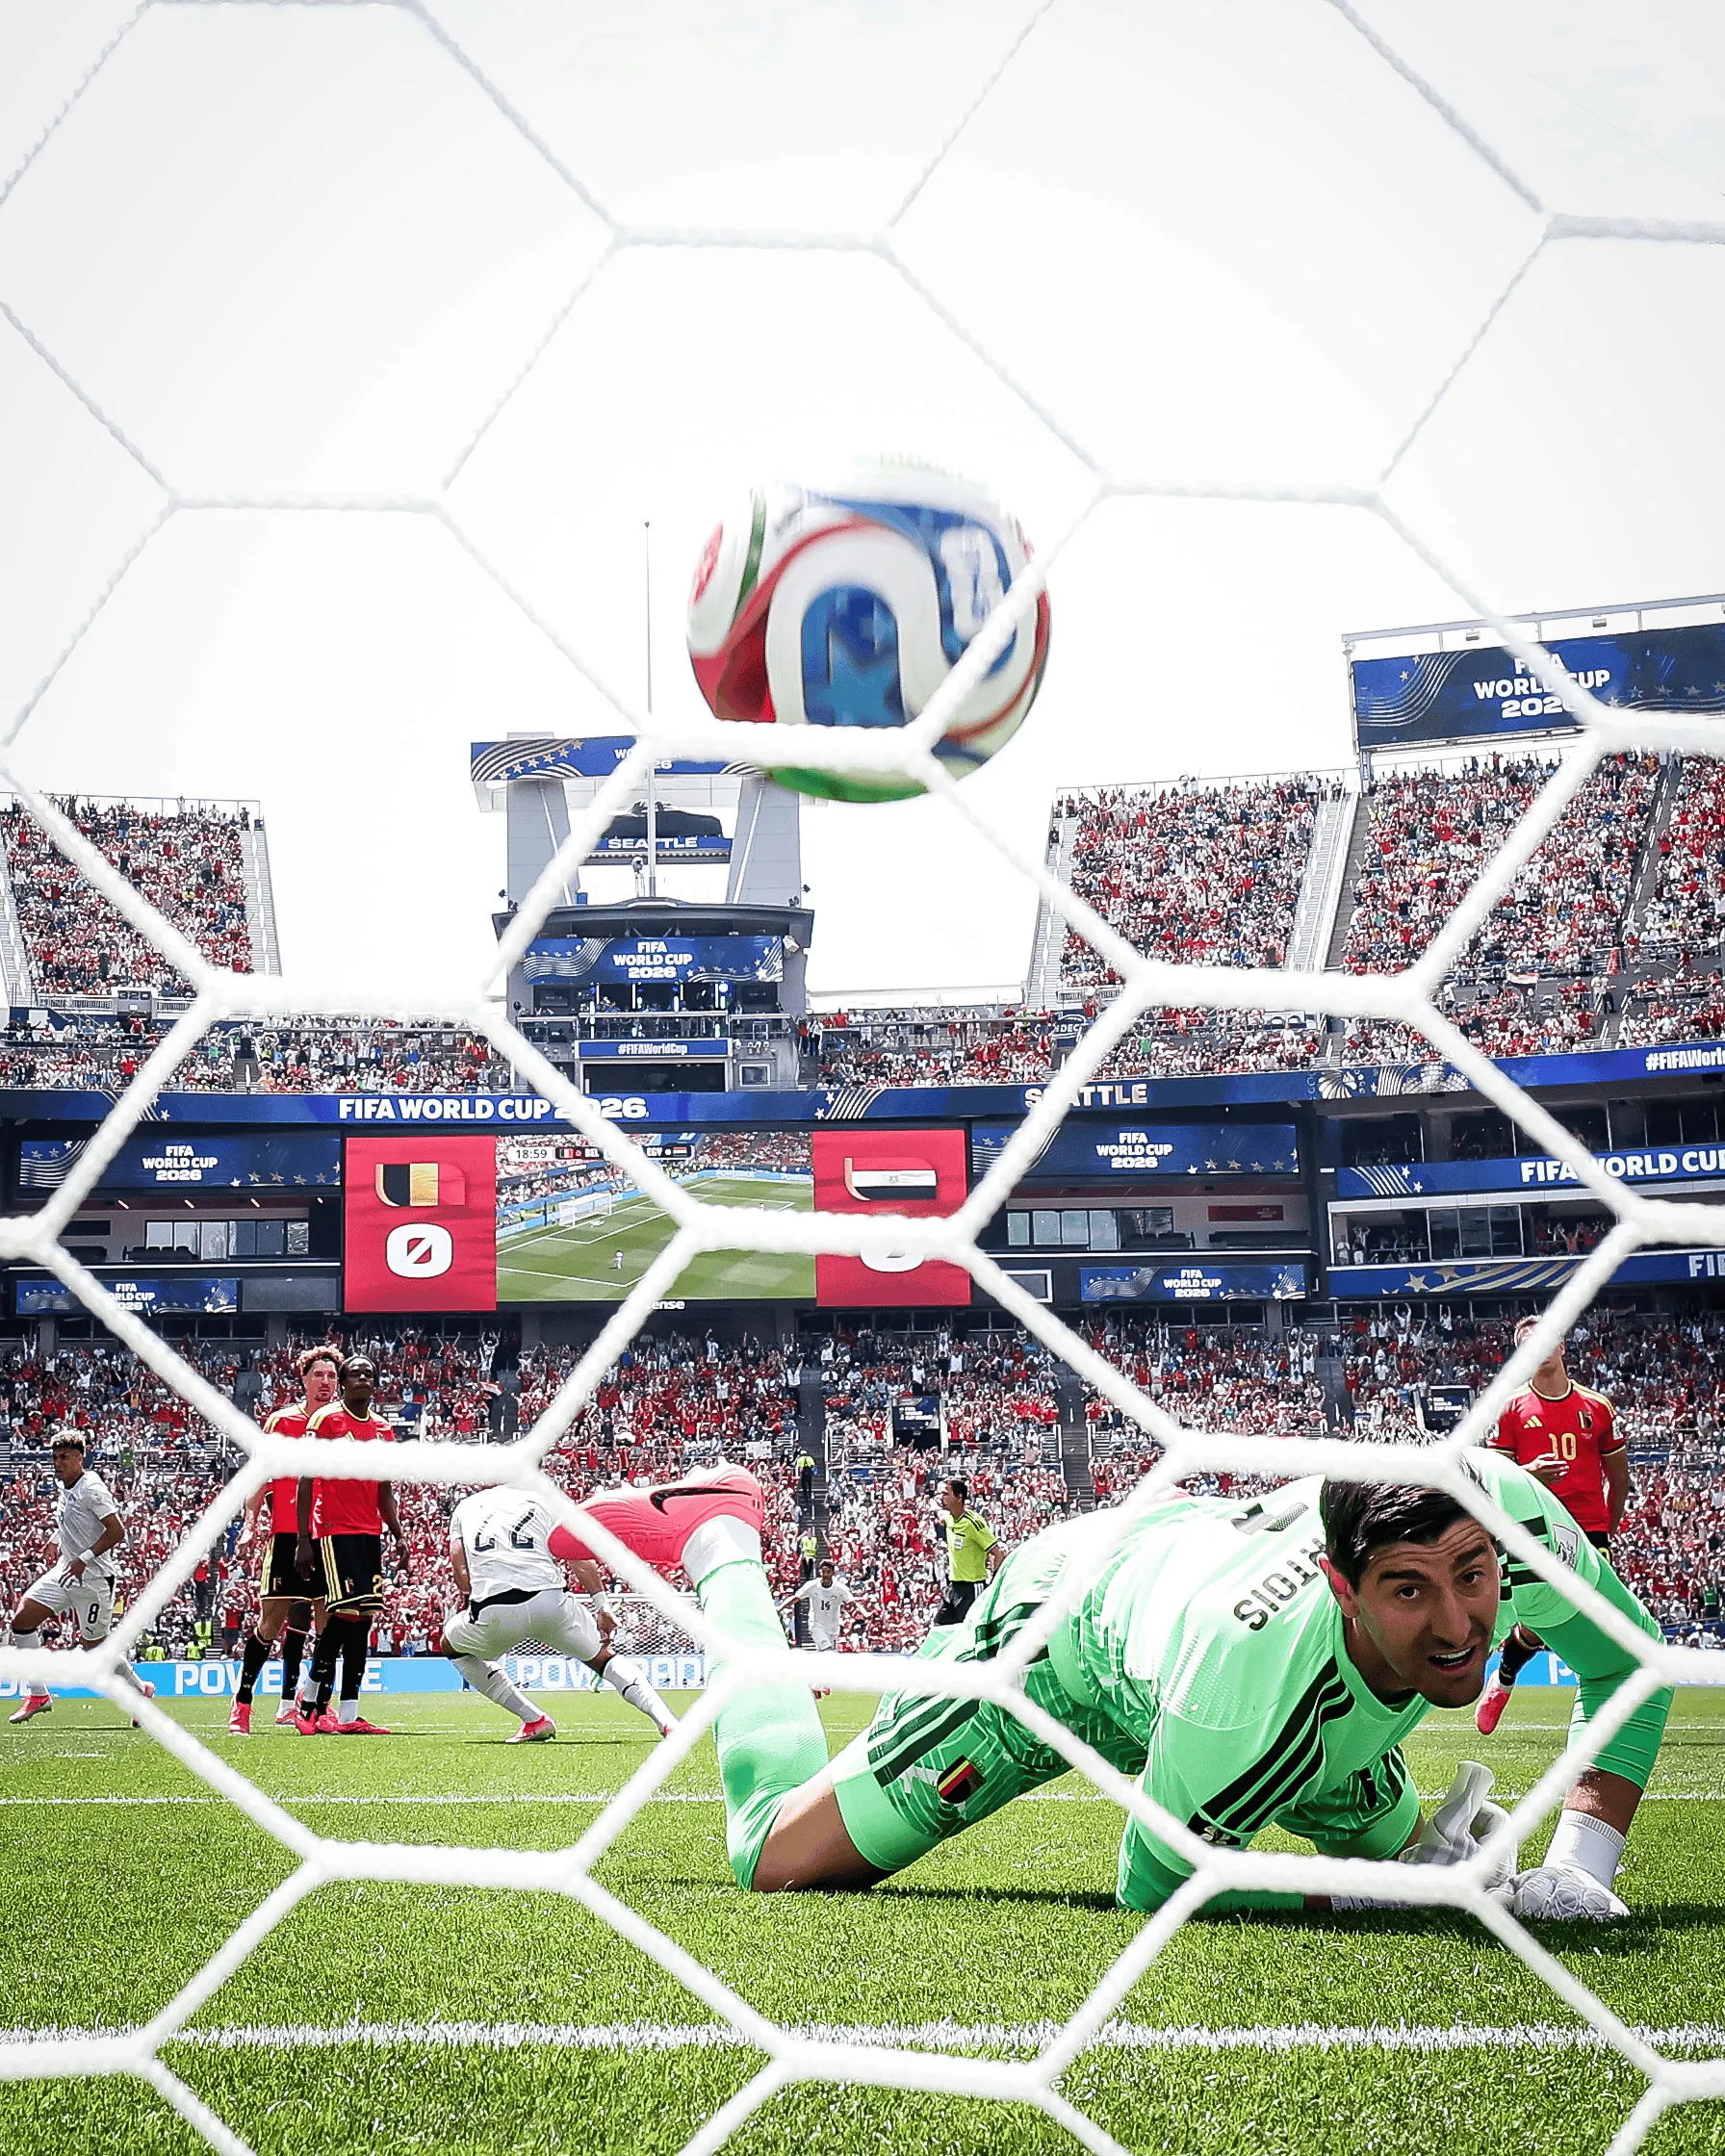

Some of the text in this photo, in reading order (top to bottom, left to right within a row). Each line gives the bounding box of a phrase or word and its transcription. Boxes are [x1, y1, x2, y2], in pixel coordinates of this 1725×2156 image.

[1514, 654, 1566, 675] FA
[1502, 696, 1577, 718] 202
[637, 941, 668, 953] FIFA
[613, 954, 693, 966] WORLD CUP
[628, 966, 677, 979] 2026
[618, 1043, 688, 1056] #FIFAWorldCup
[1645, 1047, 1725, 1071] #FIFAWorl
[1025, 1084, 1147, 1108] STTLE
[339, 1097, 646, 1119] FIFA WORLD CUP 226
[1119, 1133, 1147, 1143] FIFA
[166, 1145, 193, 1157] FIFA
[516, 1149, 547, 1159] 18:59
[1096, 1144, 1172, 1156] WORLD CUP
[142, 1157, 218, 1168] WORLD CUP
[1111, 1157, 1158, 1168] 2026
[156, 1169, 202, 1181] 2026
[1521, 1160, 1579, 1182] FIFA
[1180, 1270, 1203, 1278] FIFA
[116, 1283, 137, 1292] FIFA
[1164, 1278, 1222, 1288] WORLD CUP
[1174, 1289, 1211, 1297] 2026
[652, 1300, 685, 1310] ense
[1548, 1432, 1577, 1461] 10
[88, 1603, 100, 1625] 8
[175, 1661, 382, 1695] POWEE
[515, 1657, 704, 1688] POWAD
